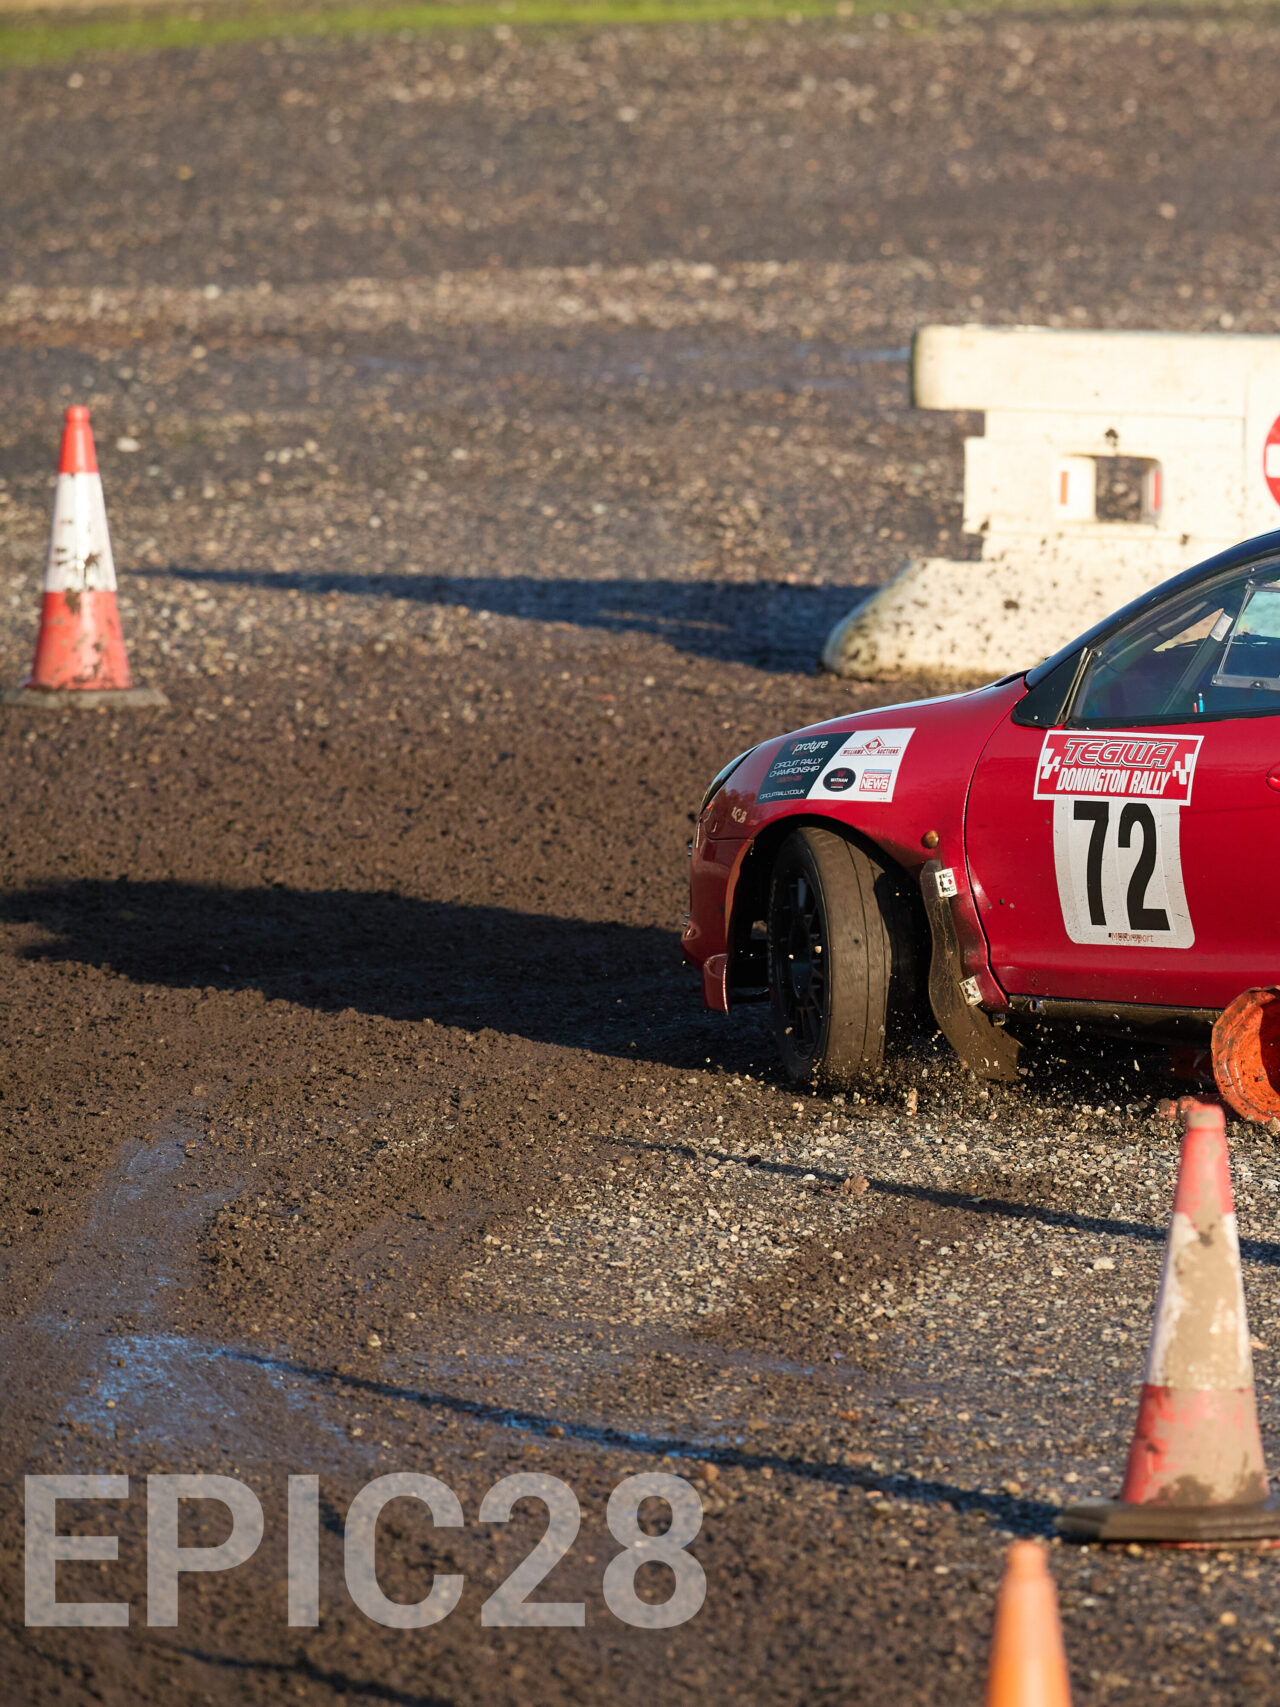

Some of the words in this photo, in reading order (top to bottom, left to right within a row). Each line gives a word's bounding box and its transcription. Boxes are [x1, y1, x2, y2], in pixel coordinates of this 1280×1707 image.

[792, 740, 829, 755] protyre
[1063, 738, 1178, 768] TEGIWA
[799, 757, 824, 766] RALLY
[768, 765, 820, 778] CHAMPIONSHIP
[860, 777, 889, 790] NEWS
[1056, 766, 1128, 793] DONINGTON
[1128, 769, 1171, 795] RALLY
[1073, 800, 1171, 930] 72
